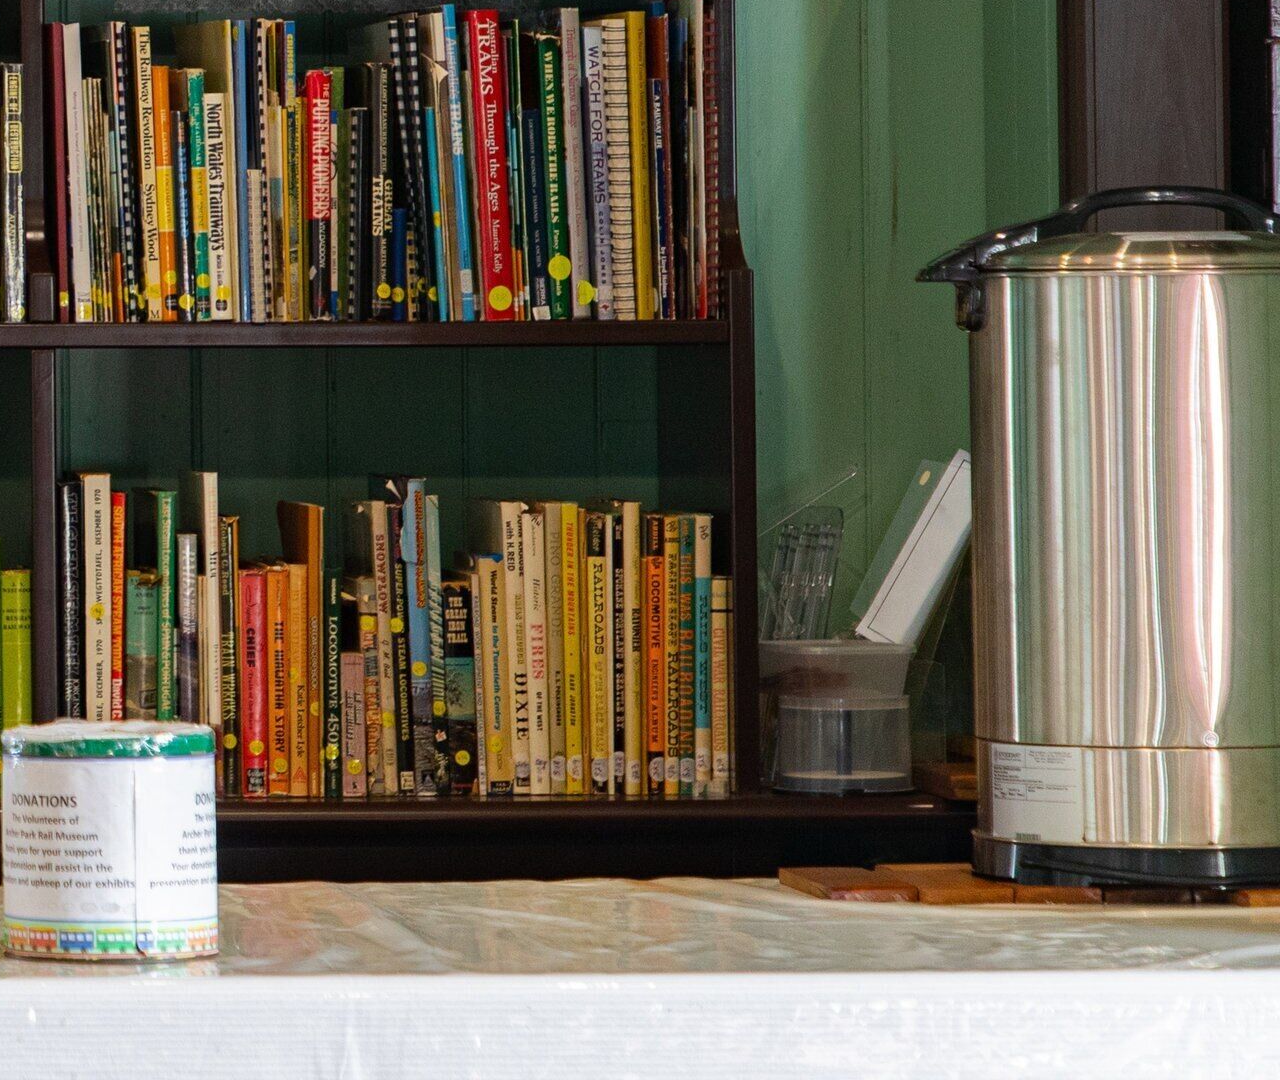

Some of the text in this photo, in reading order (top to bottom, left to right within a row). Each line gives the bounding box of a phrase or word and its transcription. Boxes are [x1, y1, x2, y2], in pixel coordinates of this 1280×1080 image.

[140, 31, 158, 261] The Railway Revolution Sydney Wood
[313, 98, 329, 218] PUFFING PIONEERS
[486, 100, 501, 211] Through the Ages
[588, 46, 605, 203] WATCH FOR TRAMS
[207, 103, 225, 250] North Wales Tramways
[593, 564, 604, 654] RAILROADS
[651, 574, 661, 649] LOCOMOTIVE
[222, 632, 236, 720] TRAIN WRECKS
[531, 623, 545, 679] FIRES
[12, 793, 77, 808] DONATIONS
[22, 814, 79, 825] Volunteers of
[38, 831, 98, 841] Rail Museum
[31, 878, 135, 890] upkeep of our exhibits
[42, 847, 103, 858] your support
